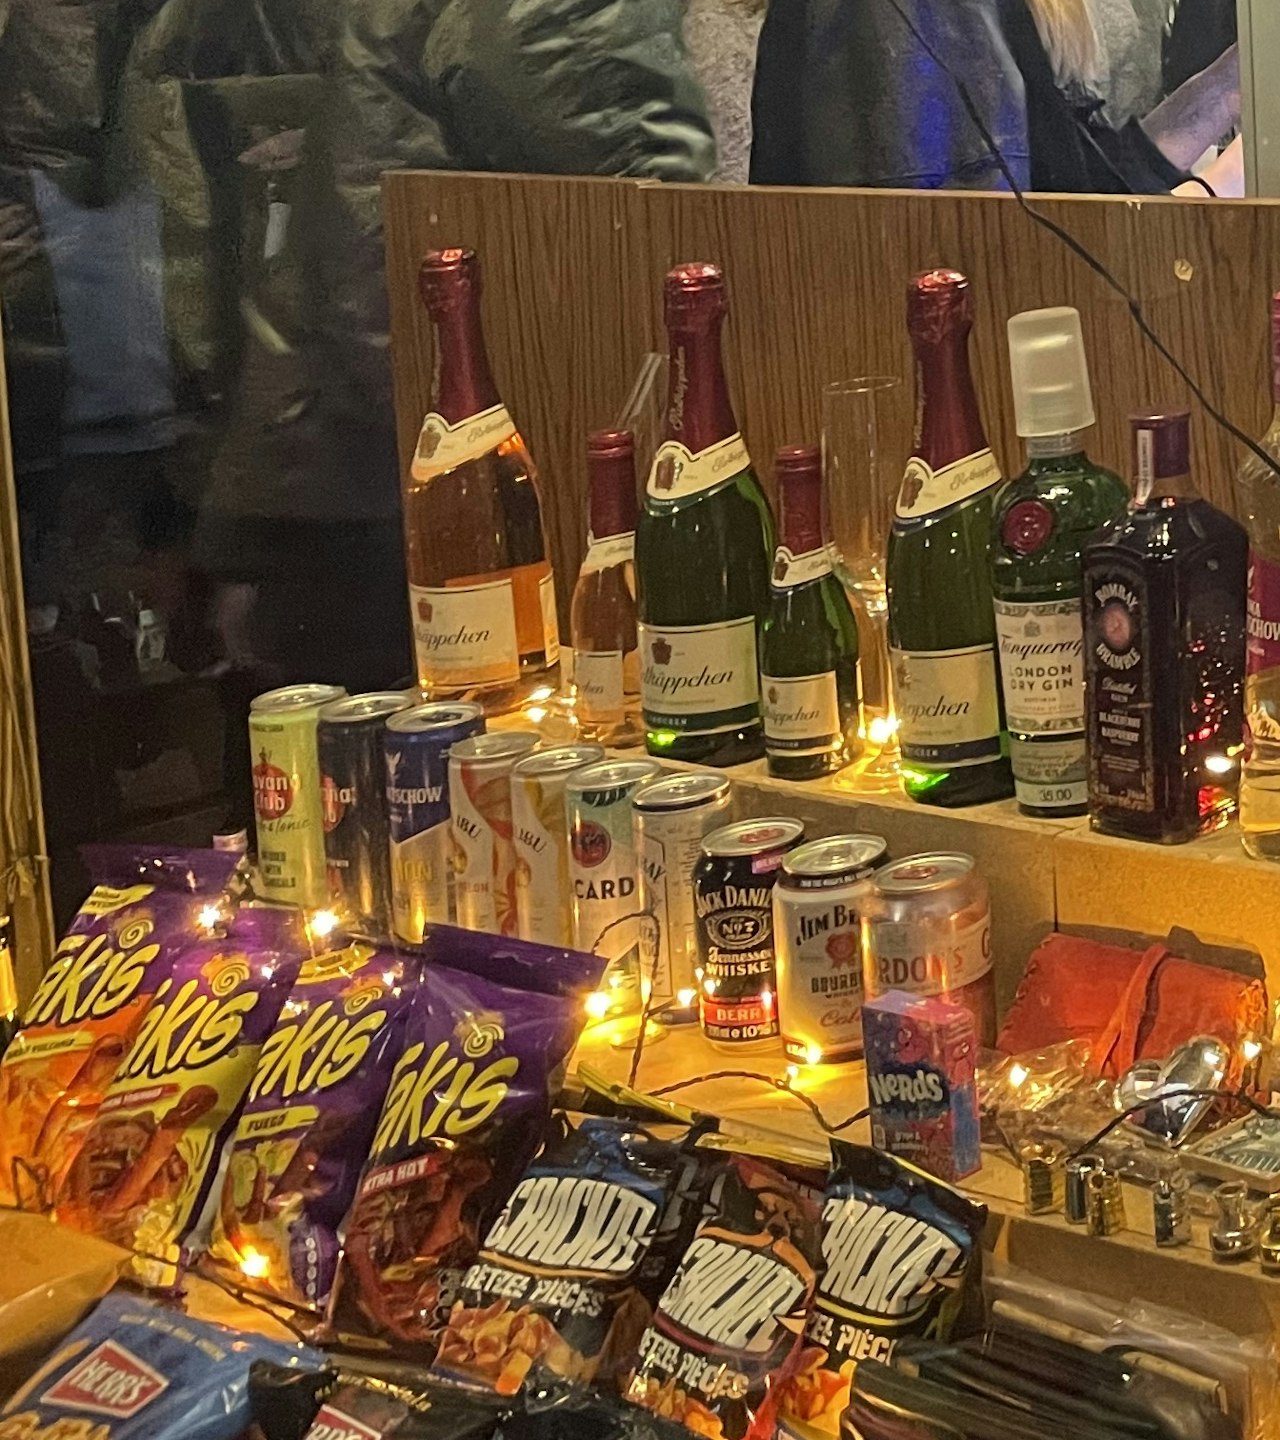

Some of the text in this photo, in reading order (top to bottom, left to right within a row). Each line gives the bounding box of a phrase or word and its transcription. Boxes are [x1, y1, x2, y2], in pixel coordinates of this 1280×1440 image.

[1094, 582, 1139, 612] BOMBAY
[1009, 663, 1073, 677] LONDON
[1096, 643, 1141, 672] BRAMBLE
[1010, 677, 1073, 692] DRY GIN
[795, 914, 830, 947] JIM
[704, 961, 772, 978] WHISKE
[810, 975, 862, 994] BOURB
[361, 1156, 429, 1194] XTRA HOT
[460, 1263, 605, 1317] RETZEL PIECES
[835, 1324, 897, 1367] PIEC
